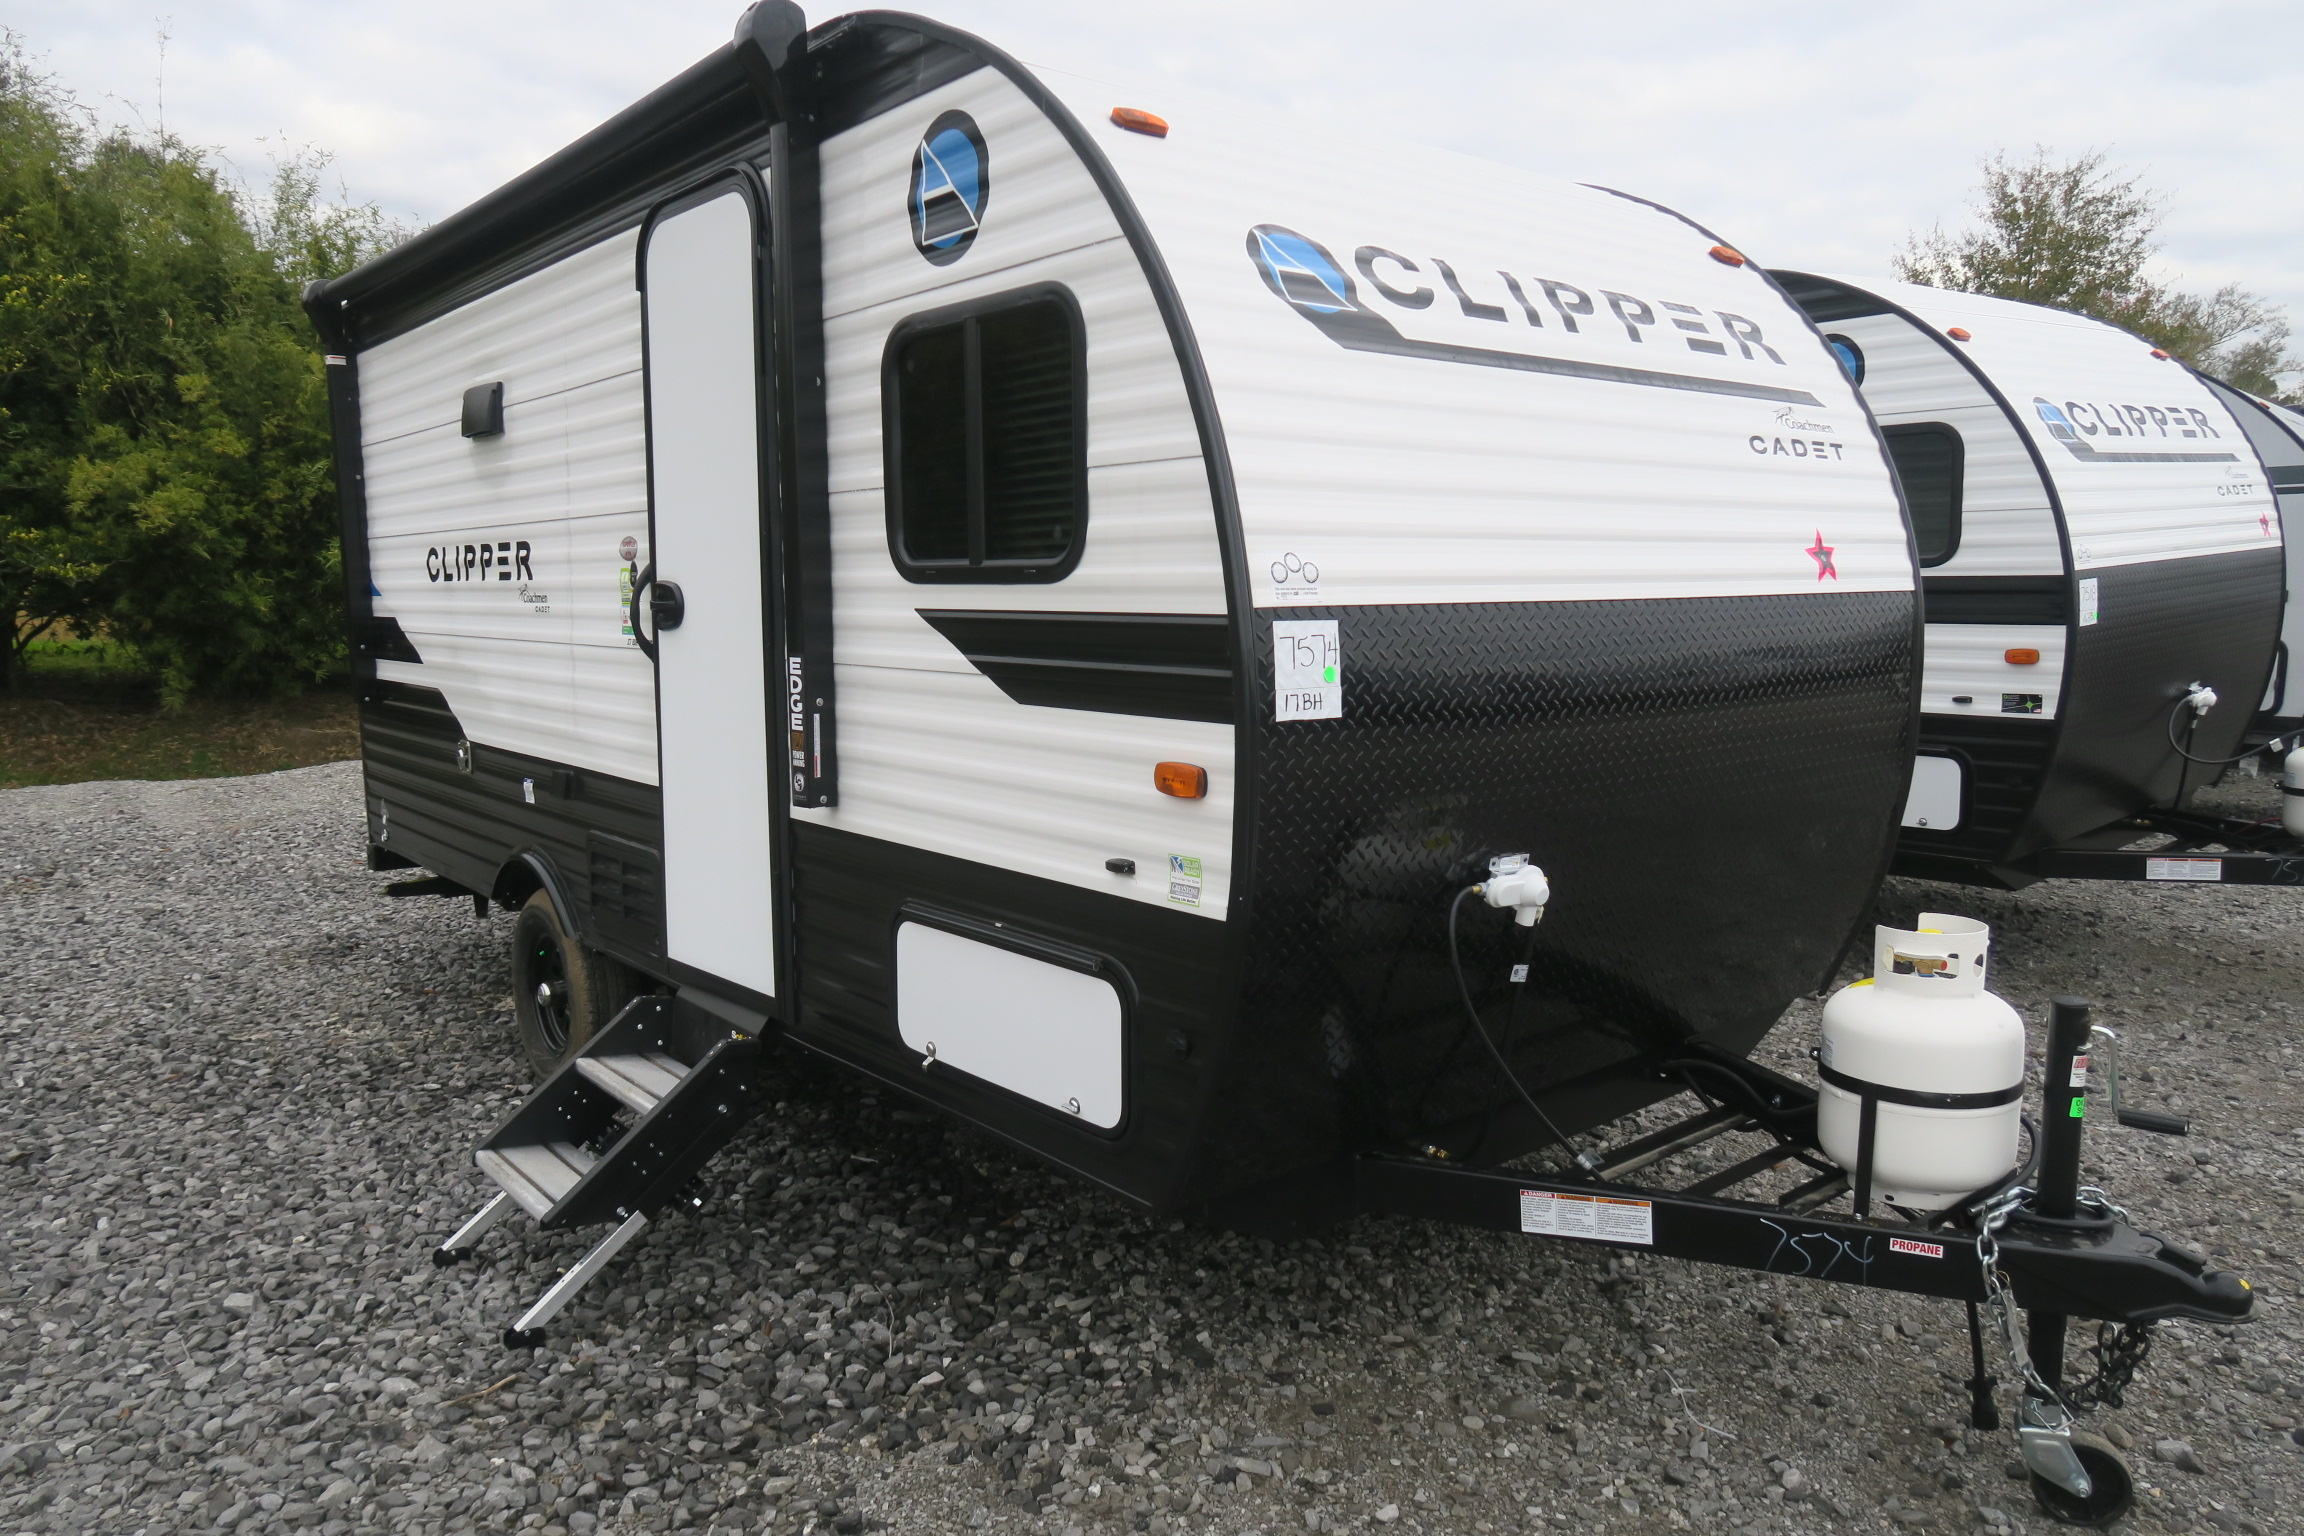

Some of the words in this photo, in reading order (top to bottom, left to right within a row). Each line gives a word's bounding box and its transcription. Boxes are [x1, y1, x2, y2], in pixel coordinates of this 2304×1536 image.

[1354, 245, 1787, 365] CLIPPER
[1784, 418, 1835, 433] Coachmen
[2065, 401, 2221, 439] CLIPPER
[1748, 435, 1843, 461] CADET
[2216, 483, 2254, 497] CADET
[426, 540, 533, 582] CLIPPER
[534, 605, 550, 613] CADET
[1279, 633, 1339, 670] 7574
[789, 656, 803, 731] EDGE
[1285, 692, 1323, 712] 17BH
[1759, 1217, 1875, 1286] 7574
[1891, 1239, 1942, 1256] PROPANE
